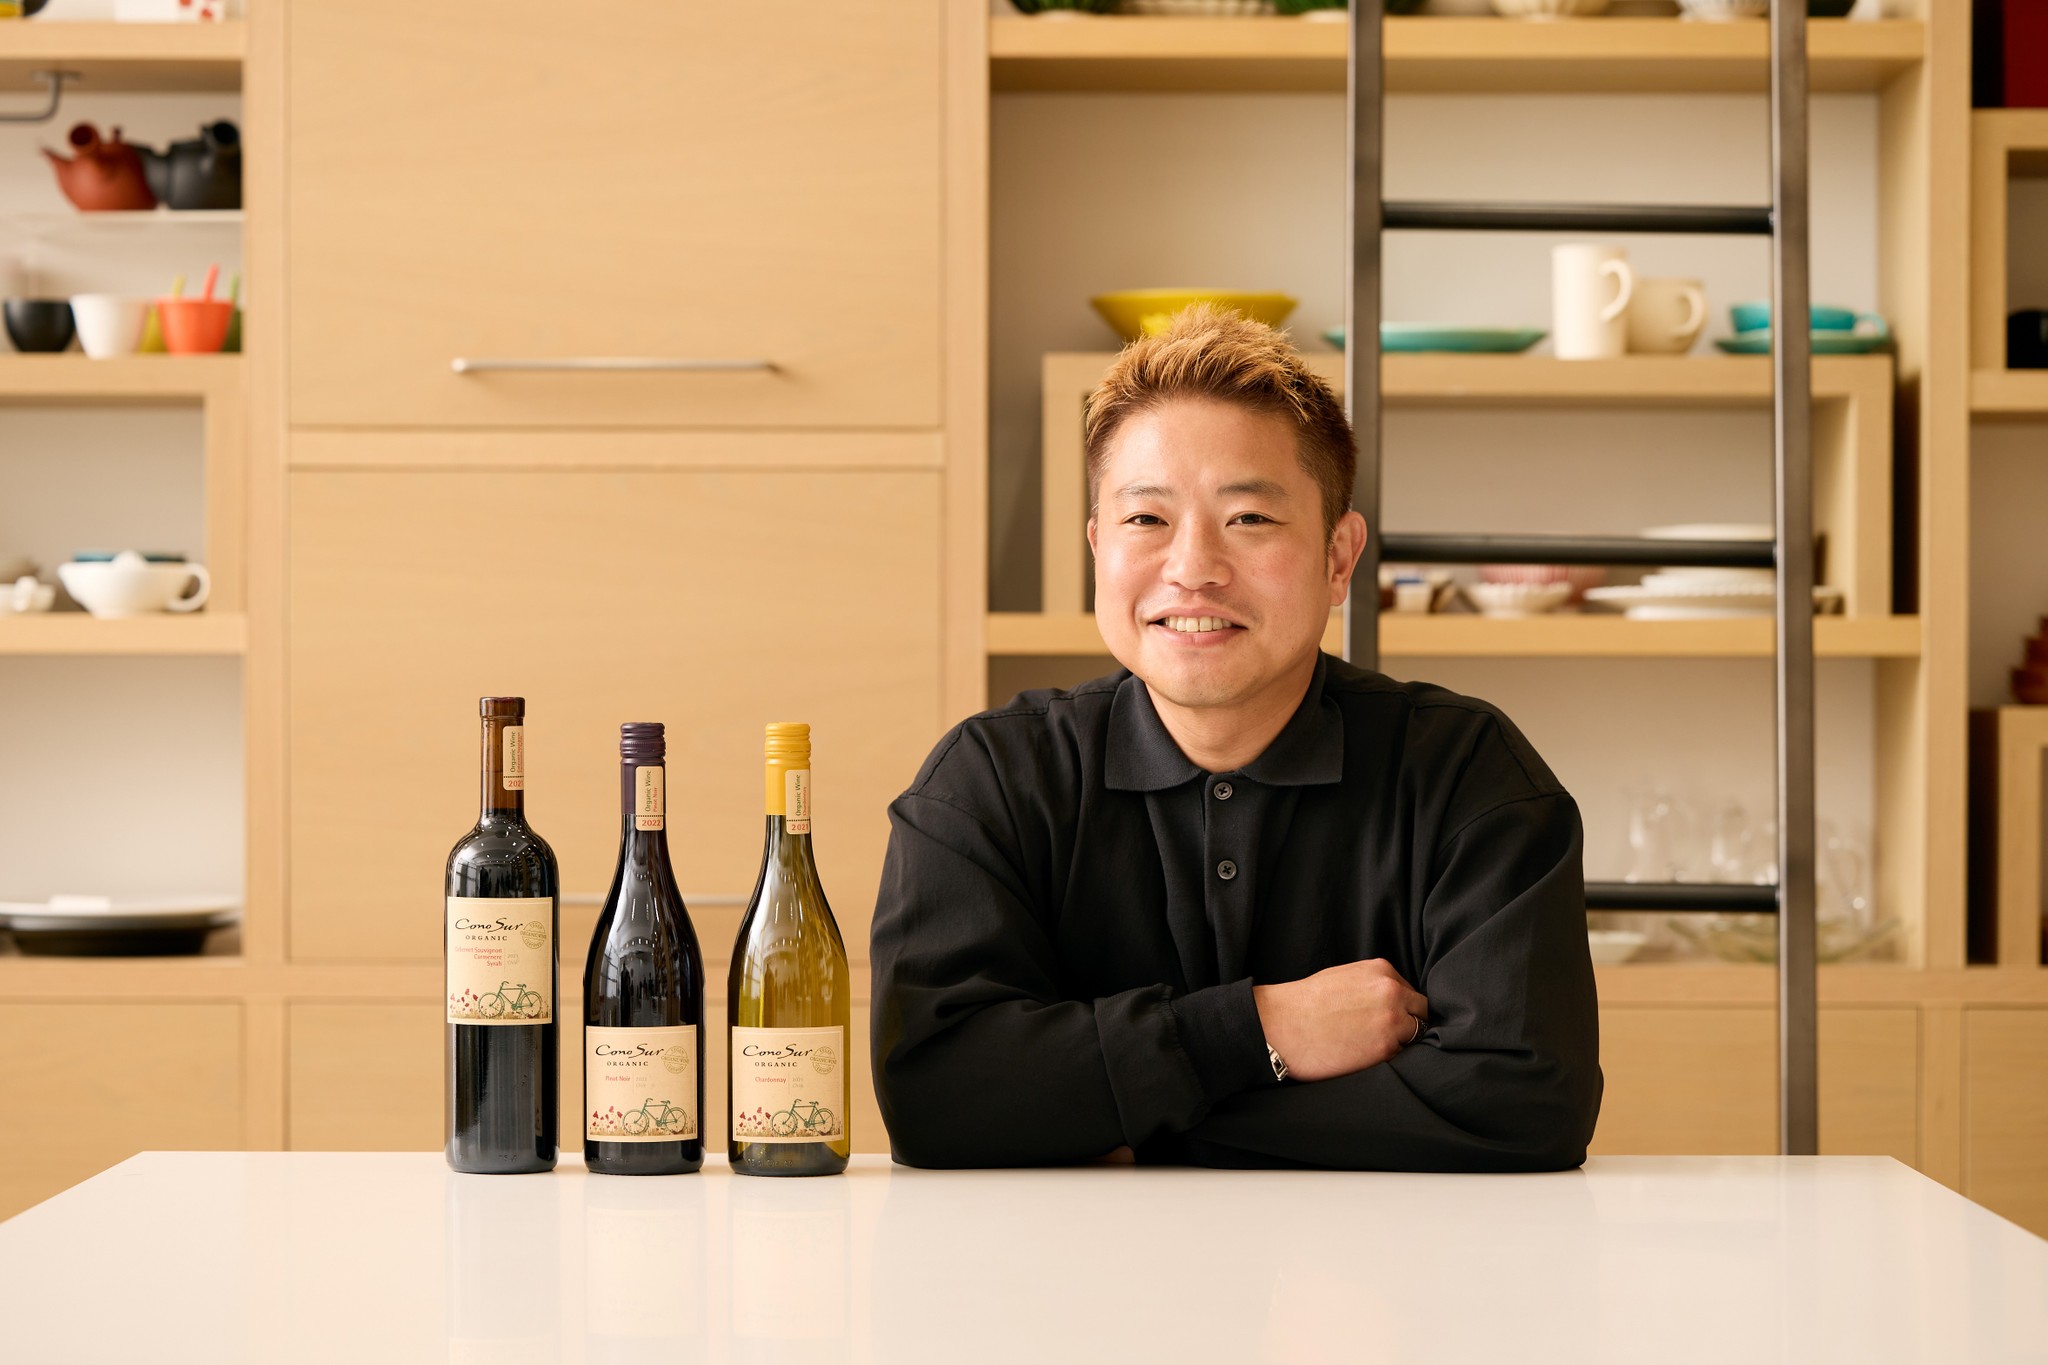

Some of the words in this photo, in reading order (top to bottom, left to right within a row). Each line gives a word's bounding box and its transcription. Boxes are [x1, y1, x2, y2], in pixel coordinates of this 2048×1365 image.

[641, 819, 661, 827] 2022
[455, 918, 491, 931] Cono
[487, 917, 523, 933] Sur
[474, 946, 503, 955] Sauvignon
[595, 1044, 633, 1056] Cono
[628, 1043, 665, 1059] Sur
[742, 1044, 781, 1057] Cono
[777, 1043, 813, 1059] Sur
